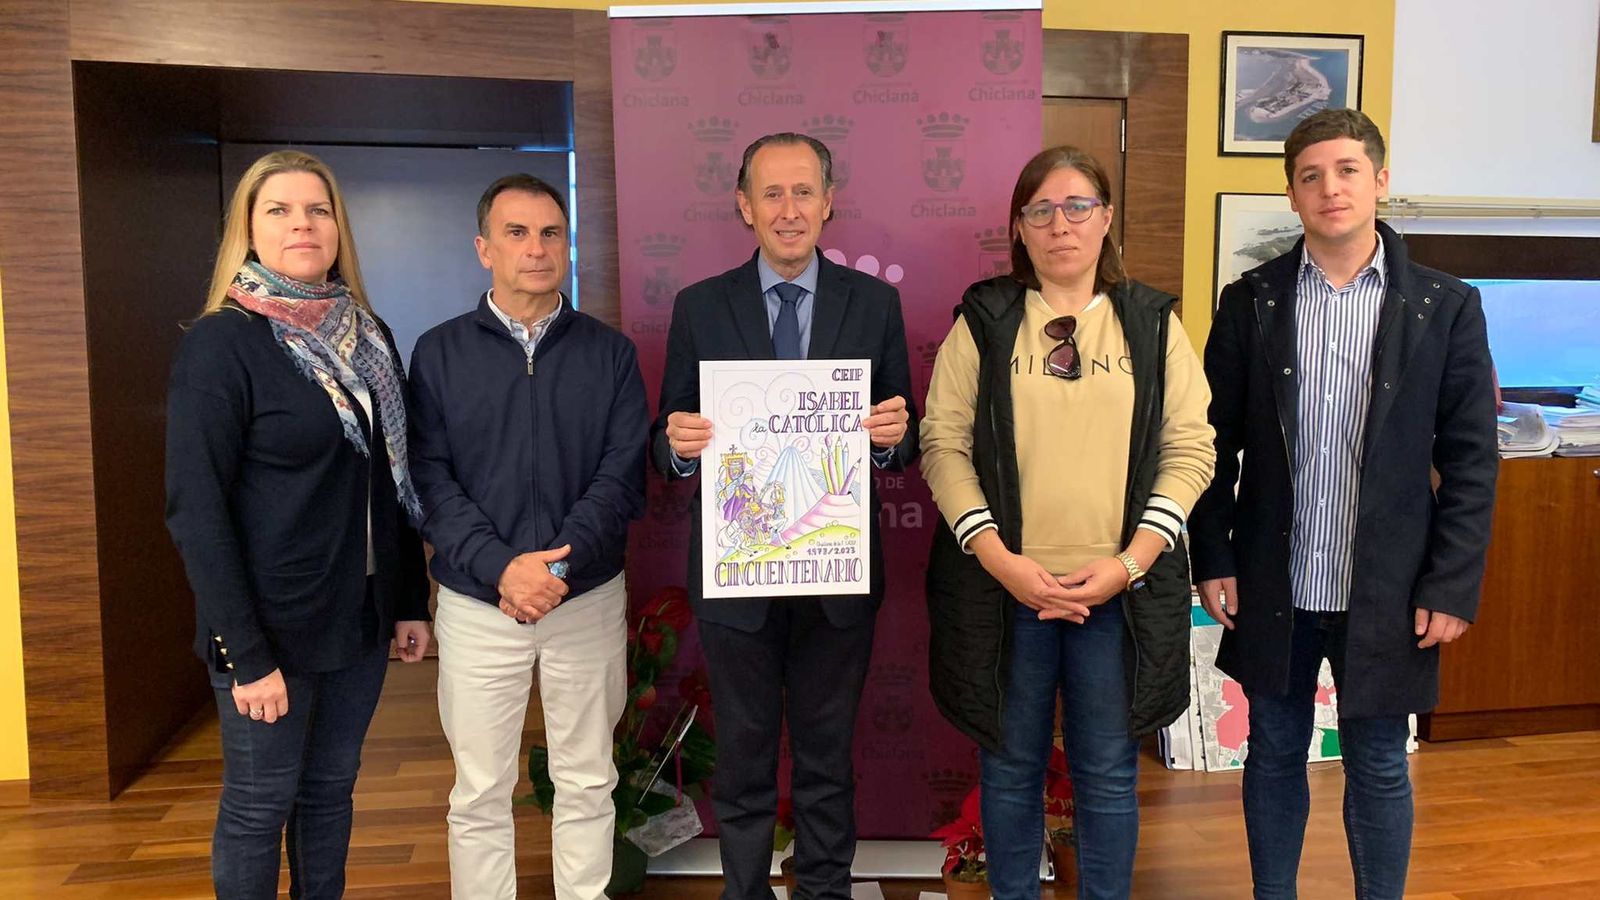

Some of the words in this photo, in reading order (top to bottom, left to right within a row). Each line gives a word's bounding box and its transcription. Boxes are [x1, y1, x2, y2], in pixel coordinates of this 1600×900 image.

[622, 91, 690, 108] Chiclana
[738, 90, 805, 107] Chiclana
[853, 87, 920, 105] Chiclana
[968, 86, 1036, 102] Chiclana
[910, 203, 977, 219] Chiclana
[831, 367, 864, 382] CEIP
[797, 391, 864, 411] ISABEL
[752, 422, 768, 434] la
[768, 411, 864, 434] CATÓLICA
[885, 477, 905, 490] DE
[714, 557, 864, 588] CINCUENTENARIO
